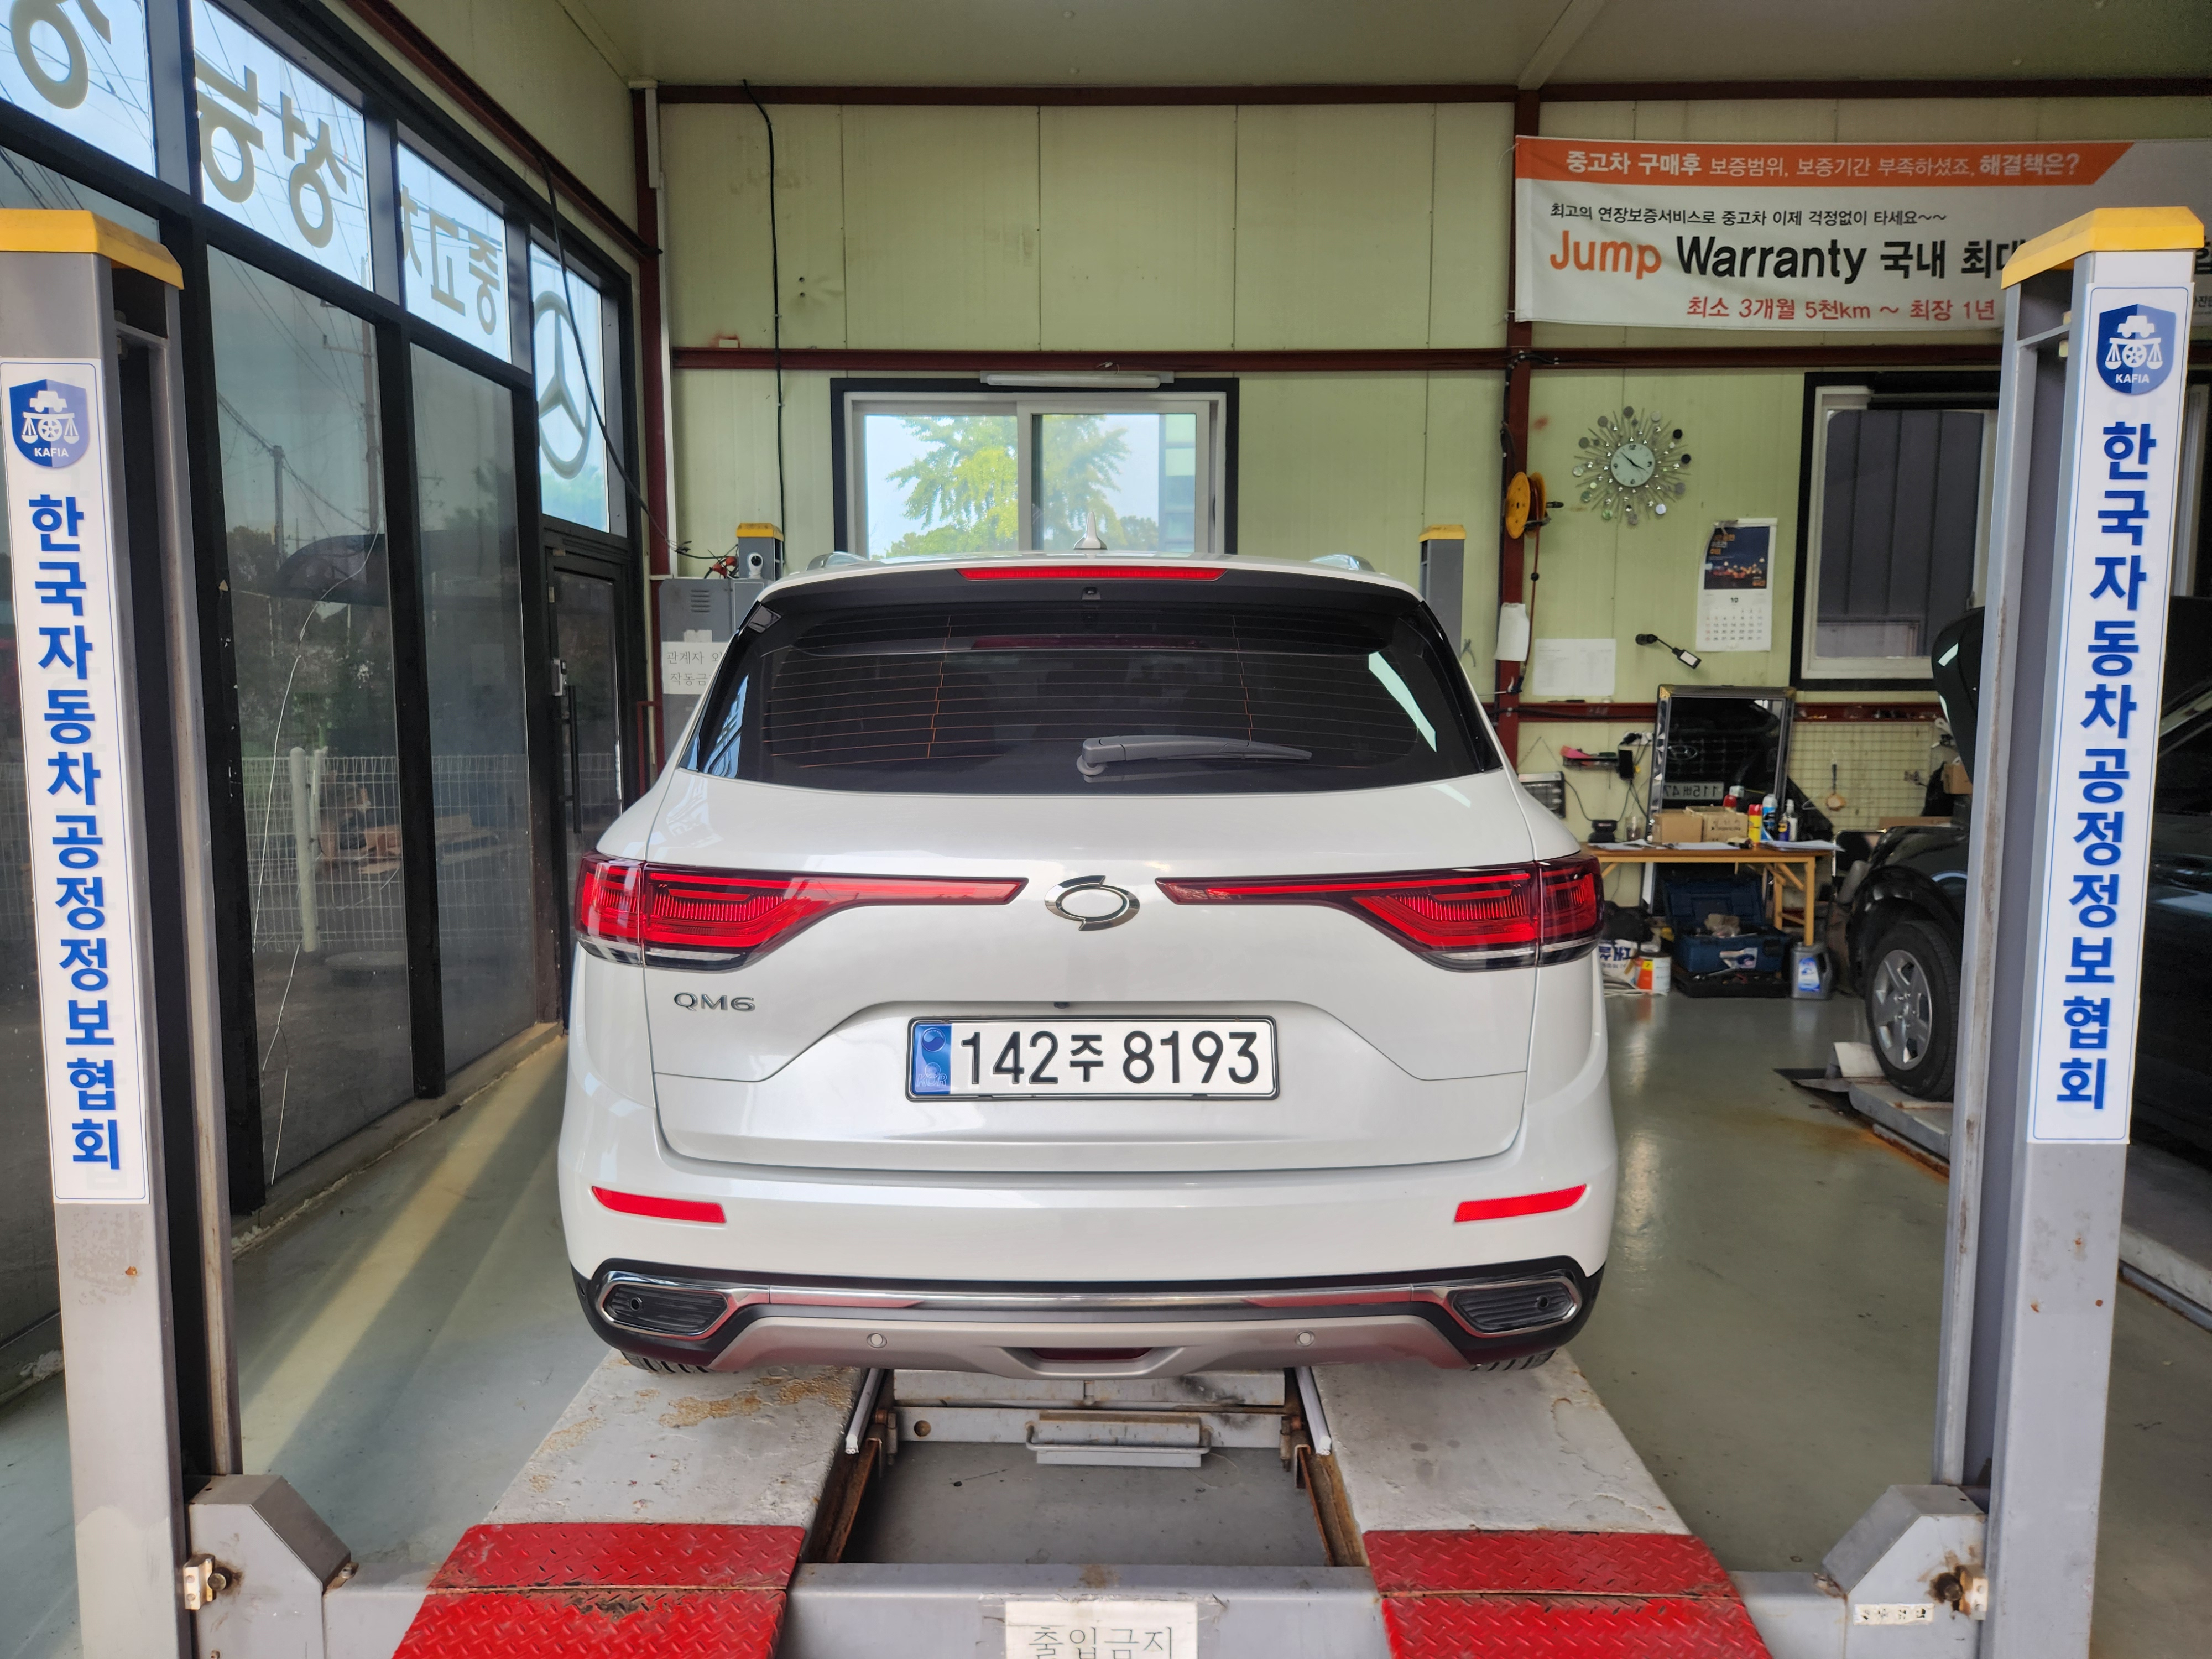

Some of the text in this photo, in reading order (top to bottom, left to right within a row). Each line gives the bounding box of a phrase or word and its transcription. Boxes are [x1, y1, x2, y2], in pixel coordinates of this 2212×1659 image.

[1566, 150, 1630, 174] 중고차
[1638, 153, 1702, 176] 구매후
[1797, 158, 1870, 176] 보증기간
[1980, 152, 2080, 176] 해결책은?
[1550, 203, 1592, 220] 최고의
[1598, 206, 1716, 224] 연장보증서비스로
[1722, 210, 1766, 225] 중고차
[1773, 210, 1802, 225] 이제
[1809, 210, 1867, 226] 걱정없이
[1550, 230, 1662, 280] Jump
[1677, 236, 1867, 284] Warranty
[1880, 240, 1945, 279] 국내
[1687, 296, 1729, 317] 최소
[1739, 298, 1795, 320] 3개월
[1805, 300, 1870, 320] 5천km
[1910, 299, 1953, 321] 최장
[1964, 299, 1995, 321] 1년
[2116, 374, 2150, 383] KAFIA
[34, 447, 69, 458] KAFIA
[667, 651, 704, 664] 관계자
[670, 672, 712, 686] 작동금
[2057, 421, 2156, 1109] 한국자동차공정정보협회
[29, 494, 120, 1169] 한국자동차공정정보협회
[674, 992, 755, 1011] QM6
[961, 1030, 1259, 1084] 142주 8193
[916, 1073, 947, 1088] KOR
[1029, 1627, 1173, 1659] 출입금지
